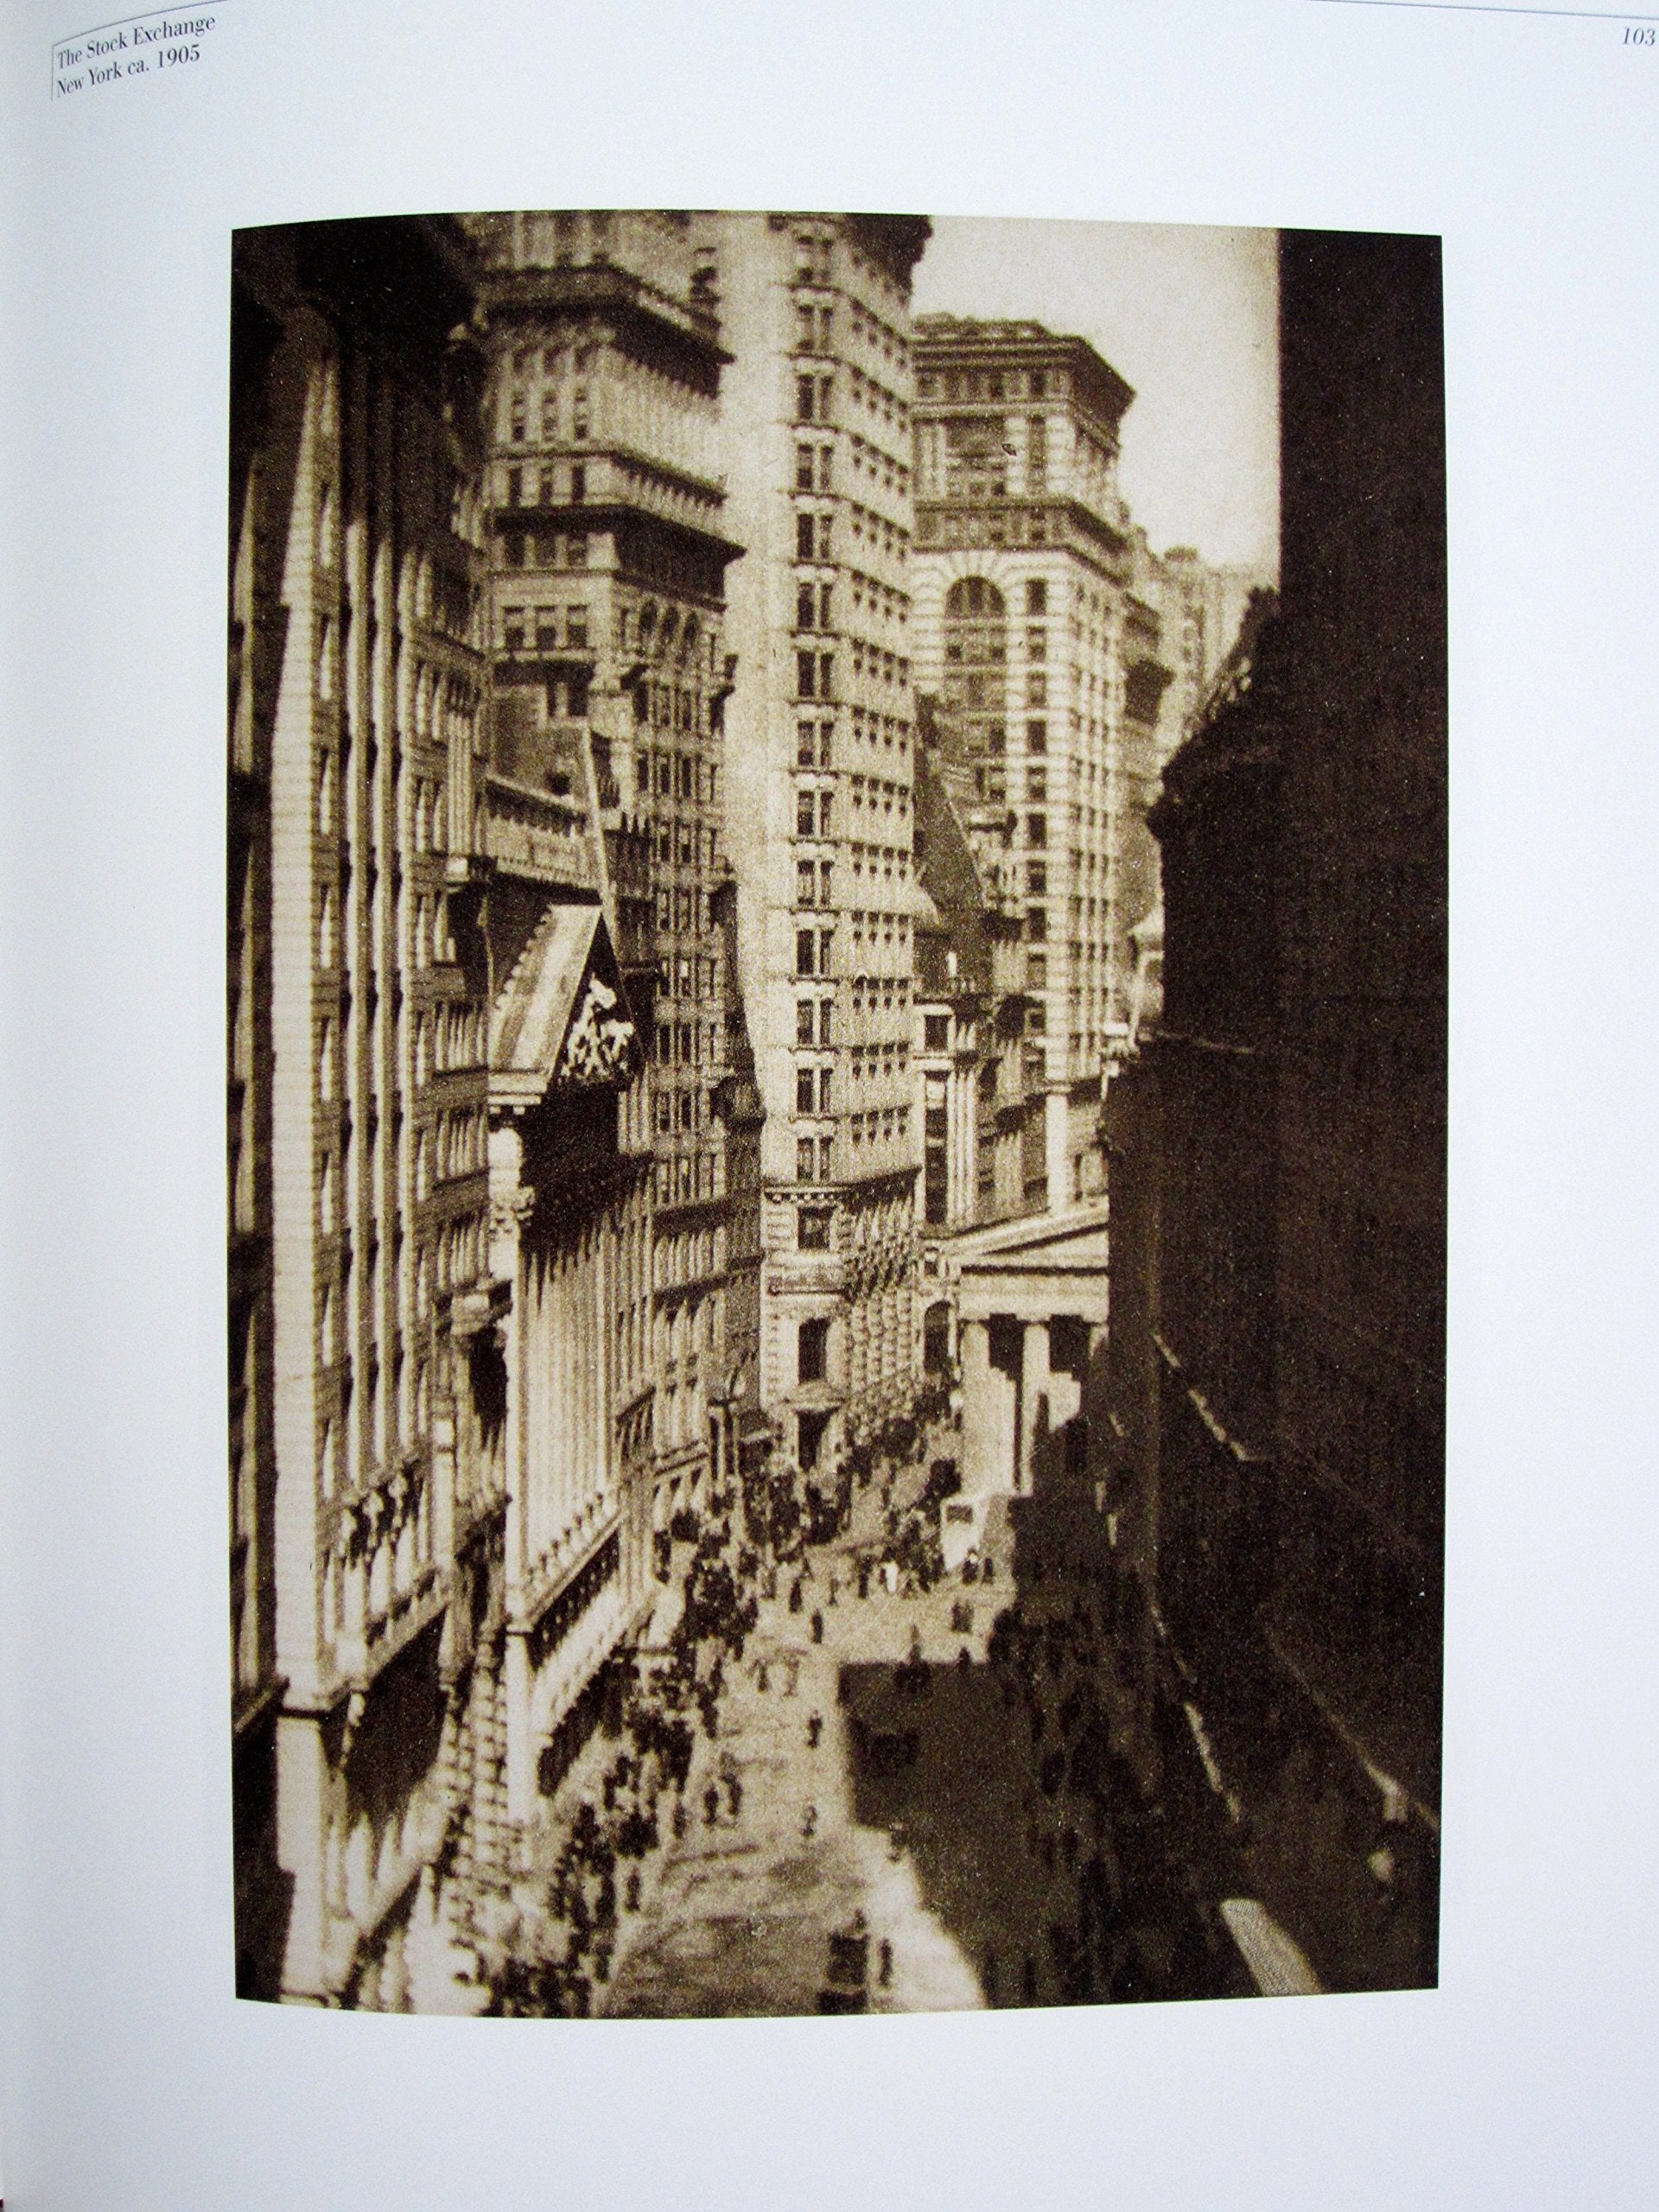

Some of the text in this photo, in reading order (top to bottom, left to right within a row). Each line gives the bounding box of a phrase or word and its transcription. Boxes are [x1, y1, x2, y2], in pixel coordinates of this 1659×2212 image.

[58, 16, 215, 69] The Stock Exchange
[1623, 27, 1656, 47] 103
[57, 43, 200, 98] New York ca. 1905
